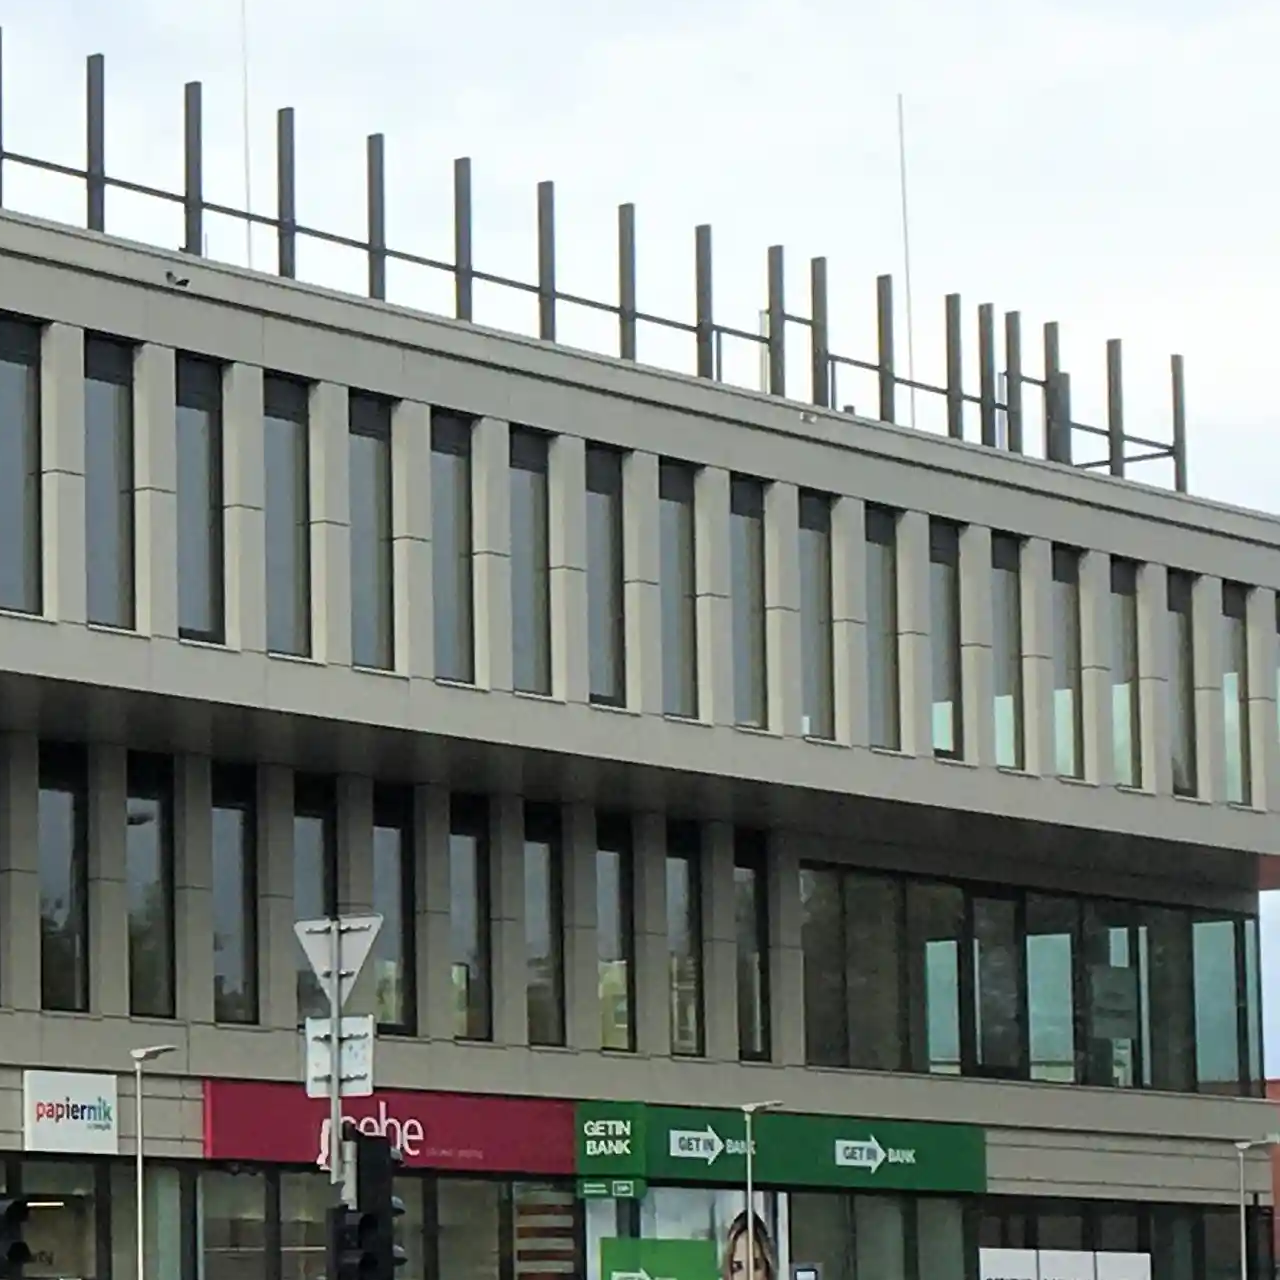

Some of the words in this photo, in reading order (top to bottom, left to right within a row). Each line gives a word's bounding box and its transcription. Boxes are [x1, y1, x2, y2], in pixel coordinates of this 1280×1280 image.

[36, 1096, 113, 1123] papiernik
[583, 1120, 631, 1136] GETIN
[585, 1139, 631, 1155] BANK
[725, 1138, 756, 1155] BANK
